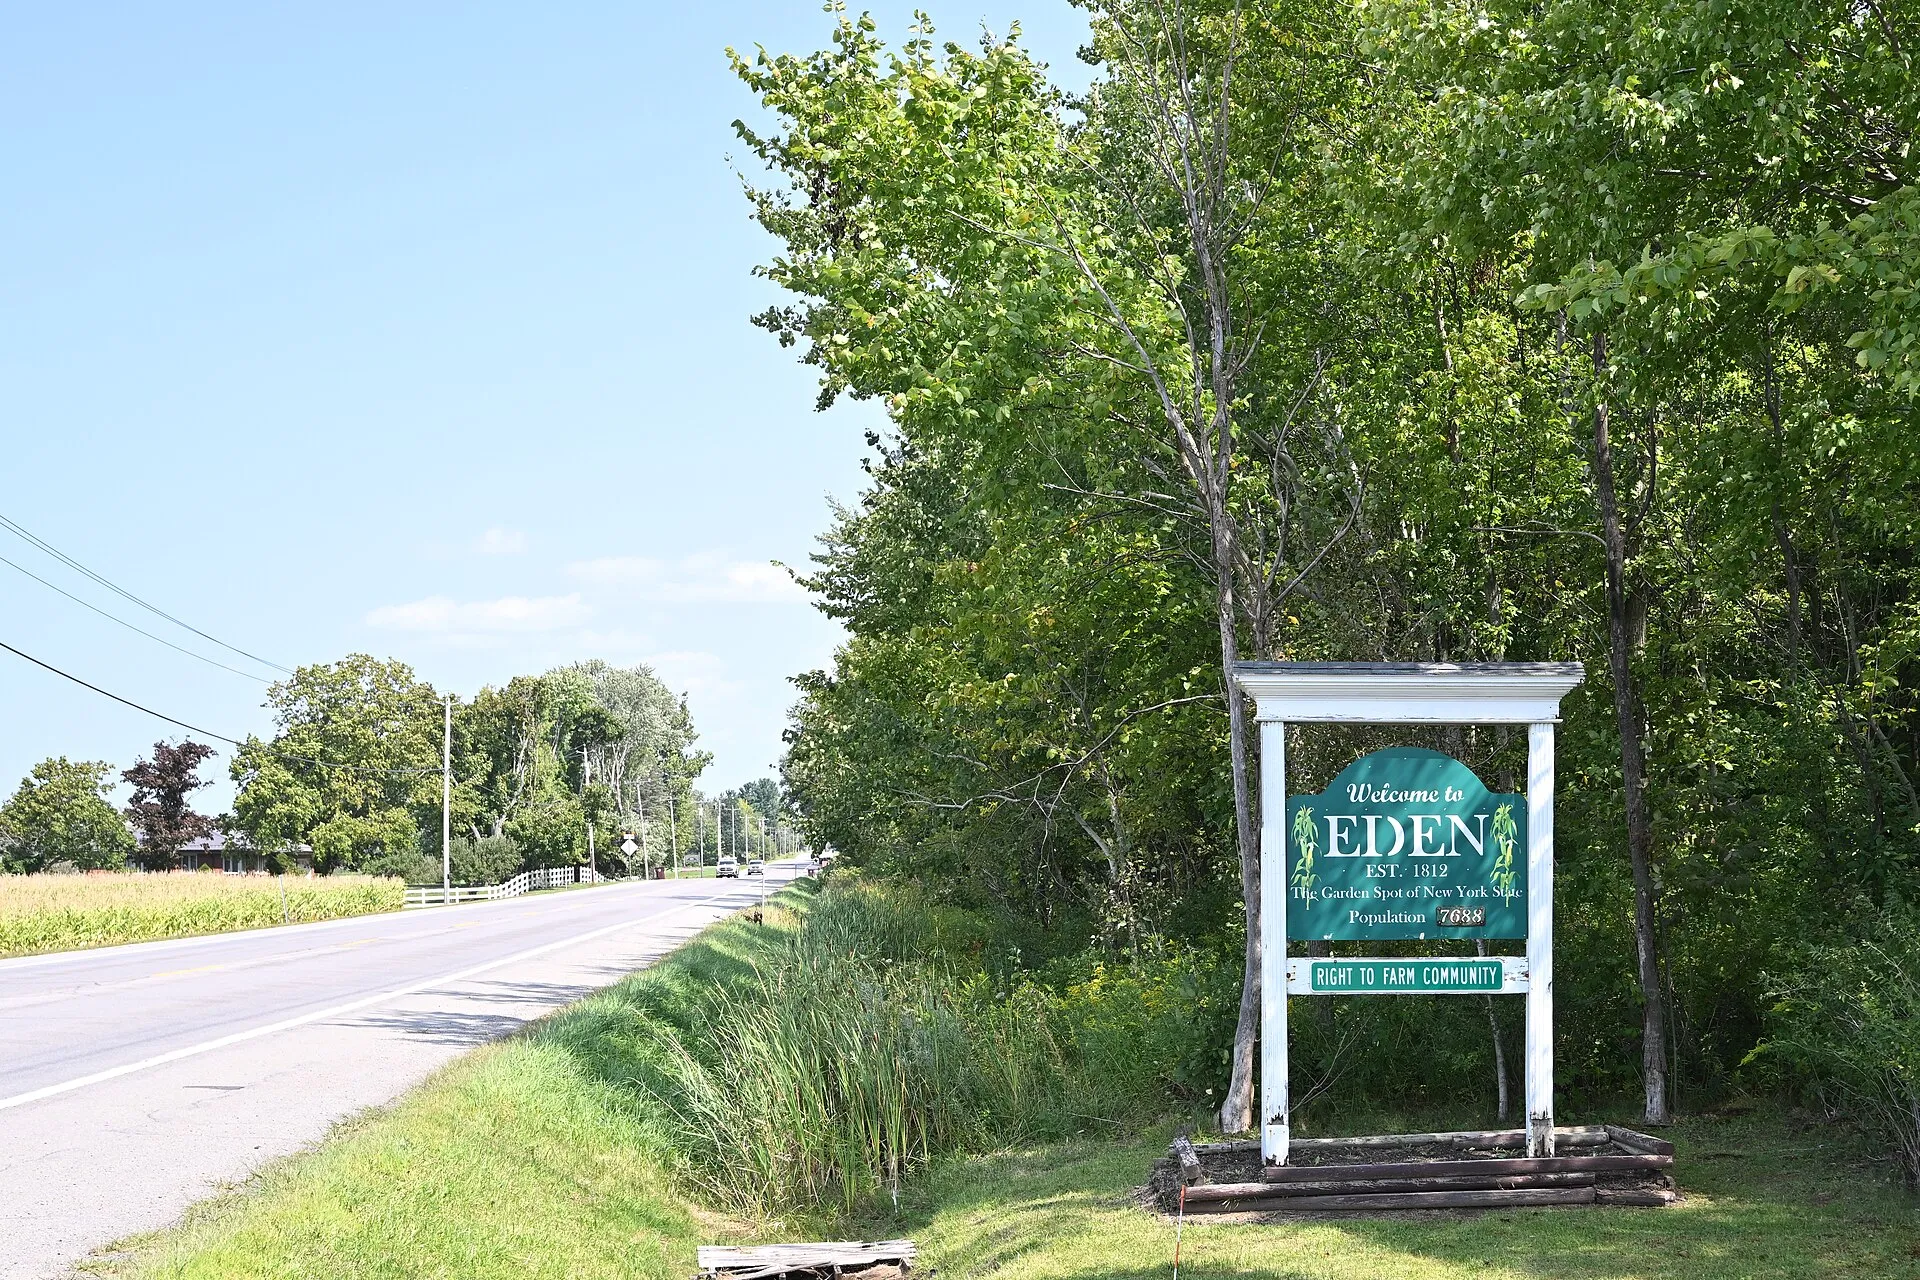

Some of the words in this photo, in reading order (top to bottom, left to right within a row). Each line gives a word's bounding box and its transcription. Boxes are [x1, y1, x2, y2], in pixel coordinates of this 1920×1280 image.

[1347, 783, 1439, 803] Welcome
[1445, 784, 1464, 802] to
[1323, 814, 1489, 857] EDEN
[1366, 865, 1403, 878] EST.
[1413, 864, 1448, 877] 1812
[1322, 886, 1370, 899] Garden
[1374, 886, 1403, 901] Spot
[1406, 886, 1421, 898] of
[1424, 886, 1453, 899] New
[1456, 886, 1488, 898] York
[1349, 910, 1426, 926] Population
[1440, 908, 1482, 923] 7688
[1317, 967, 1353, 985] RIGHT
[1360, 967, 1374, 985] TO
[1384, 967, 1415, 984] FARM
[1423, 967, 1497, 984] COMMUNITY
